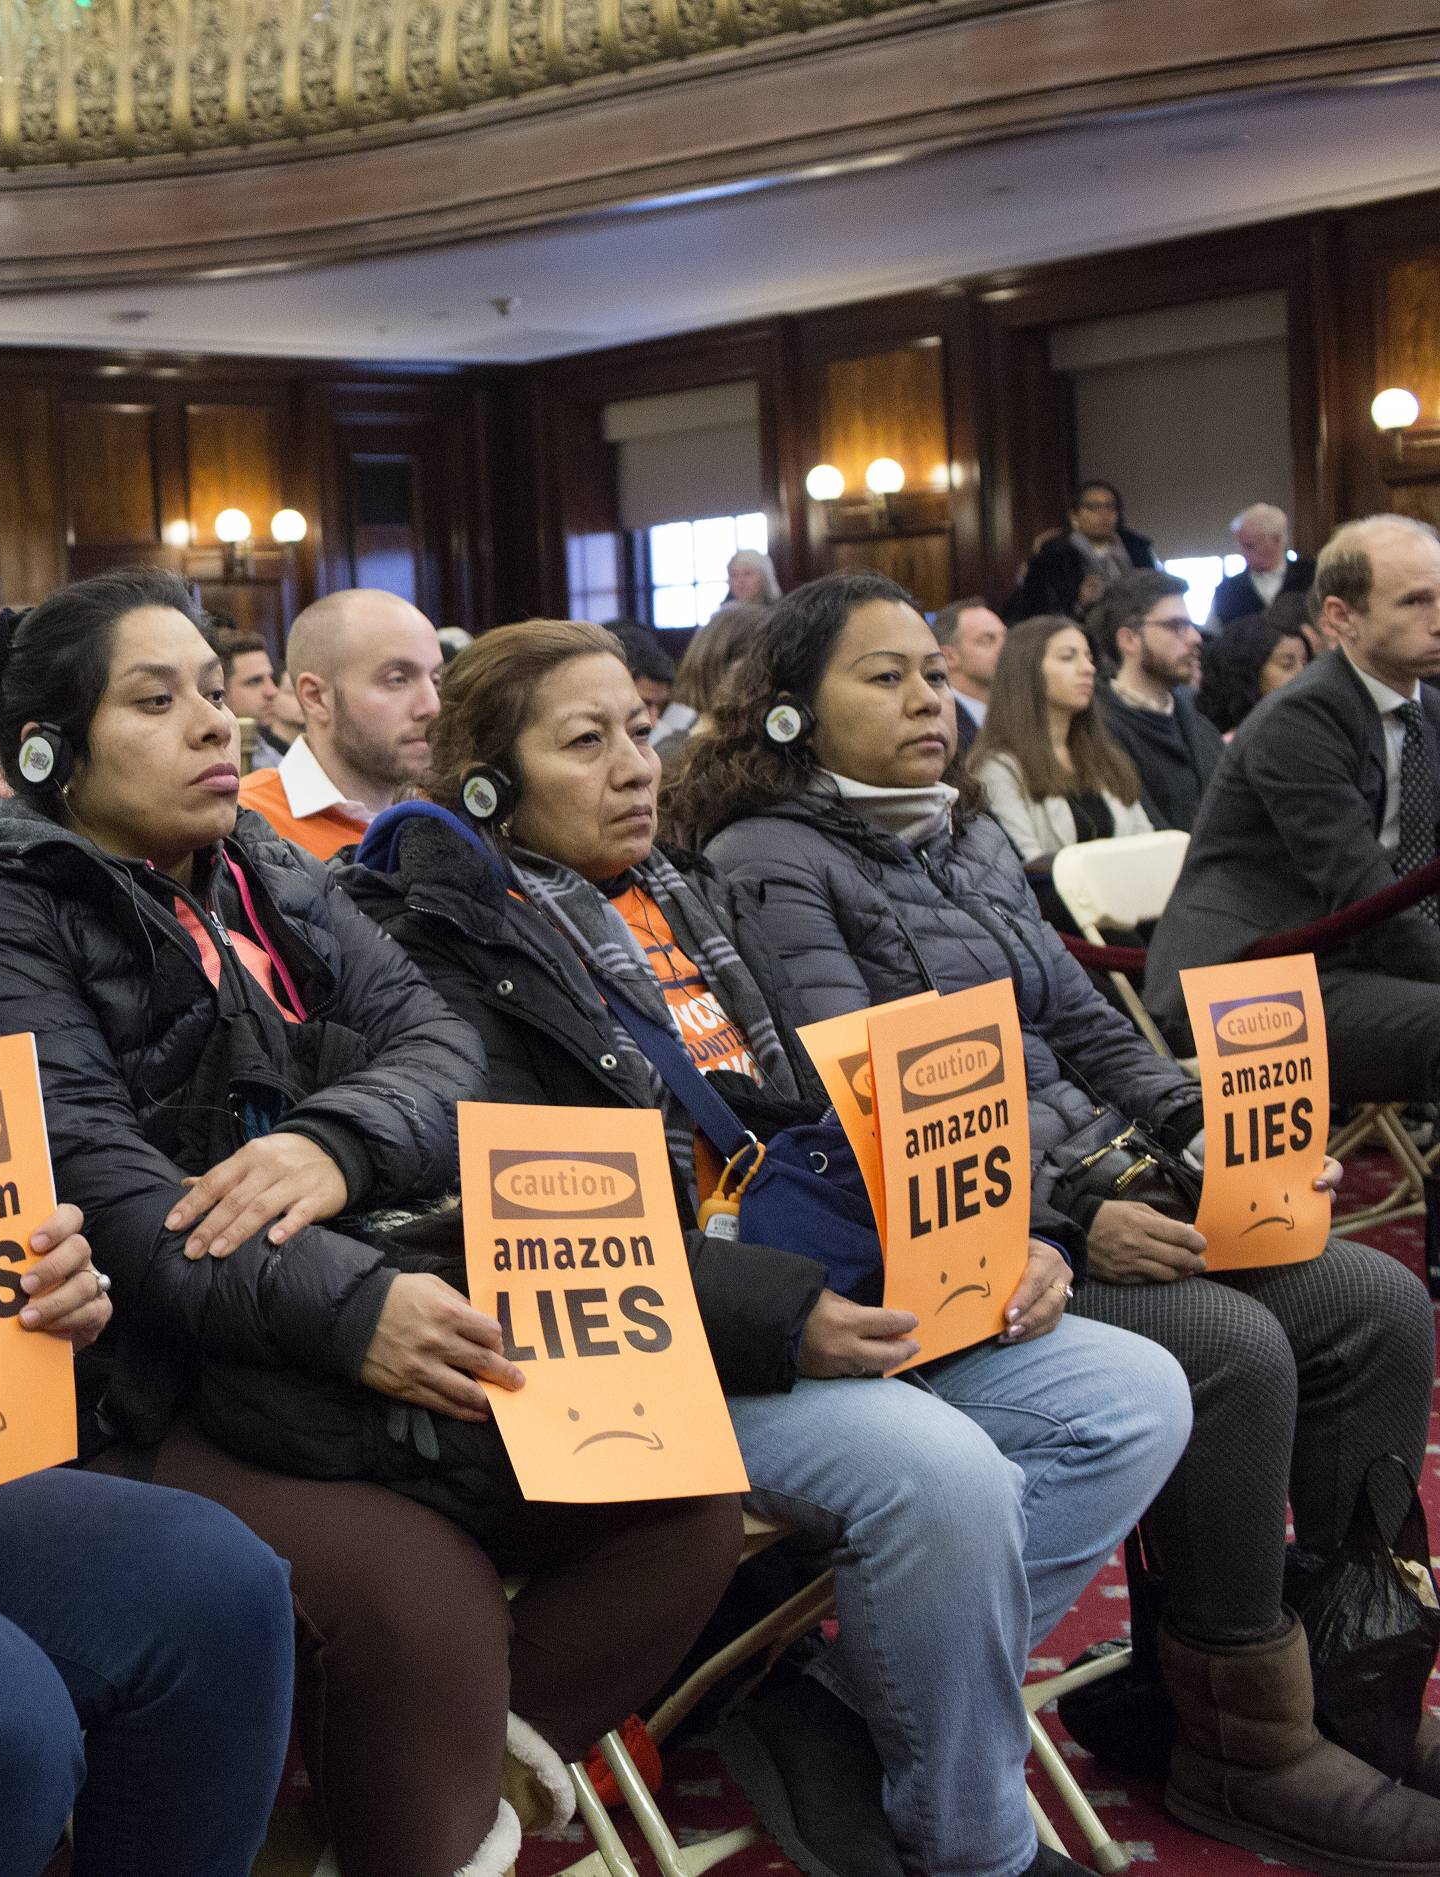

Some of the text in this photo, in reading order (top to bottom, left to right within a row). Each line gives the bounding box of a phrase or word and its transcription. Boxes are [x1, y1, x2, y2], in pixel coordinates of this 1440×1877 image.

[1226, 1008, 1294, 1037] caution
[914, 1047, 989, 1088] caution
[1221, 1055, 1313, 1098] amazon
[905, 1098, 1010, 1160] amazon
[1224, 1097, 1314, 1168] LIES
[510, 1166, 617, 1197] caution
[908, 1145, 1012, 1240] LIES
[493, 1235, 656, 1271] amazon
[496, 1285, 673, 1362] LIES
